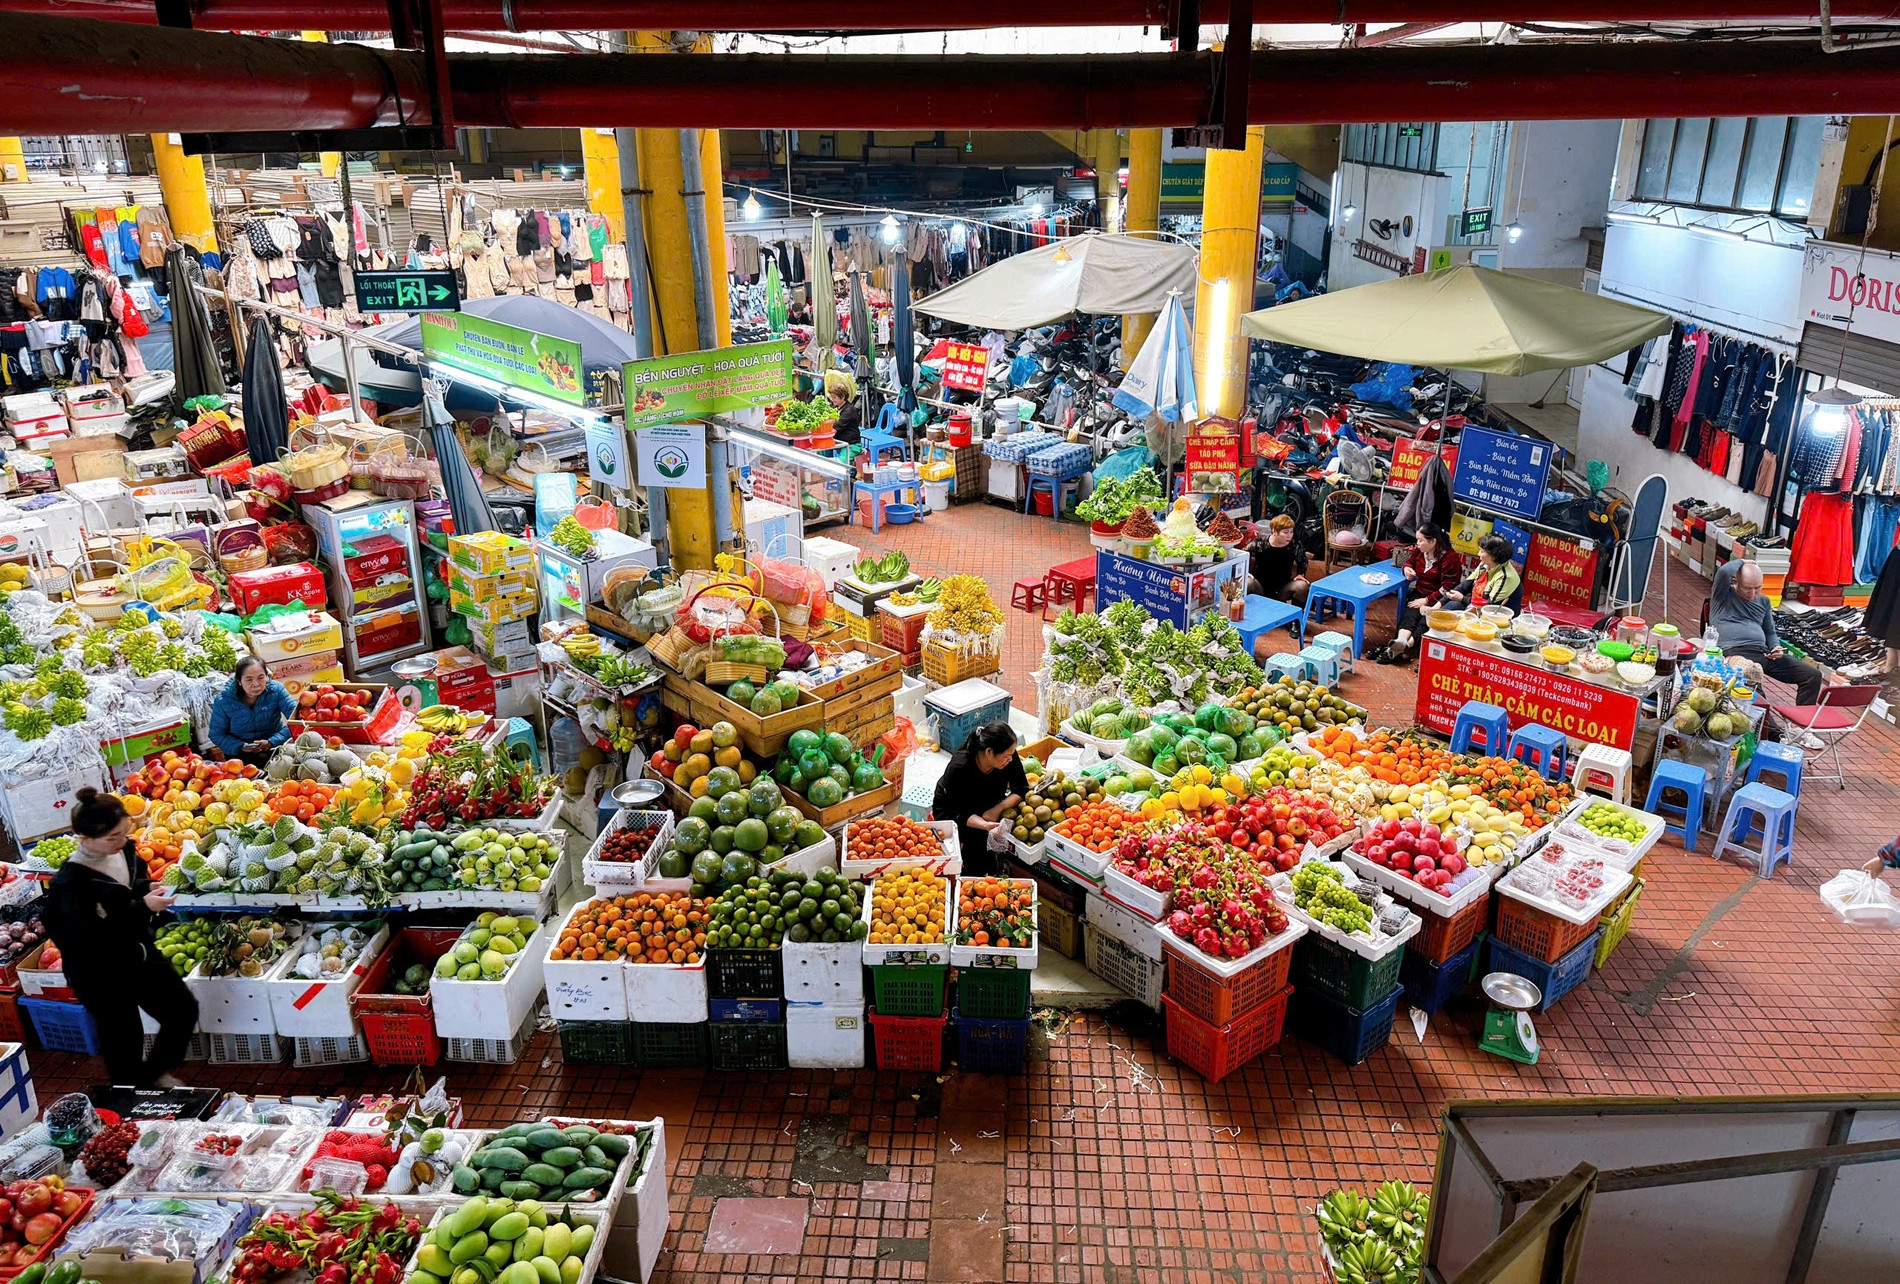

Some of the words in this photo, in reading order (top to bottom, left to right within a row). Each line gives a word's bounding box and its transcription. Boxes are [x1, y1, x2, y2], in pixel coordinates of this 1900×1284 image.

[1469, 212, 1488, 224] EXIT
[360, 280, 372, 290] LỐI
[373, 280, 396, 290] THOÁT
[366, 296, 394, 305] EXIT
[662, 362, 706, 380] NGUYỆT
[714, 360, 736, 372] HOA
[738, 354, 760, 368] QUẢ
[762, 350, 786, 364] TƯƠI
[1126, 372, 1148, 390] Dairy
[662, 382, 694, 395] CHUYÊN
[1203, 437, 1218, 448] THẬP
[1496, 438, 1510, 448] Bún
[1398, 450, 1423, 467] ĐẶC
[1492, 452, 1506, 462] Bún
[1390, 464, 1404, 478] SỮA
[1468, 460, 1482, 472] Bún
[1470, 475, 1484, 486] Bún
[1469, 487, 1479, 497] ĐT:
[1479, 490, 1490, 500] 091
[1491, 493, 1504, 504] 662
[1504, 496, 1520, 509] 7473
[1457, 530, 1474, 542] 60
[360, 558, 380, 569] envy
[1539, 554, 1562, 572] THẬP
[1562, 558, 1584, 578] CẨM
[1146, 568, 1170, 586] Nộm
[1527, 570, 1550, 587] BÁNH
[1550, 578, 1569, 594] BỘT
[1570, 586, 1590, 601] LỌC
[303, 588, 321, 597] Apple
[372, 632, 390, 642] envy
[281, 664, 302, 672] PEARS
[1472, 658, 1484, 668] chè
[1489, 662, 1500, 672] ĐT:
[1501, 666, 1524, 680] 09166
[1524, 673, 1546, 686] 27473
[1553, 681, 1572, 694] 0926
[1573, 687, 1582, 696] 11
[1584, 690, 1603, 702] 5239
[1457, 663, 1472, 674] STK:
[1478, 670, 1536, 694] 19026283436039
[1537, 687, 1592, 712] (Teckcombank)
[1444, 696, 1462, 708] XANH
[1432, 673, 1460, 694] CHÈ
[1506, 691, 1540, 720] CẨM
[1542, 706, 1575, 730] CÁC
[1577, 718, 1618, 745] LOẠI
[1428, 713, 1449, 726] THẠCH
